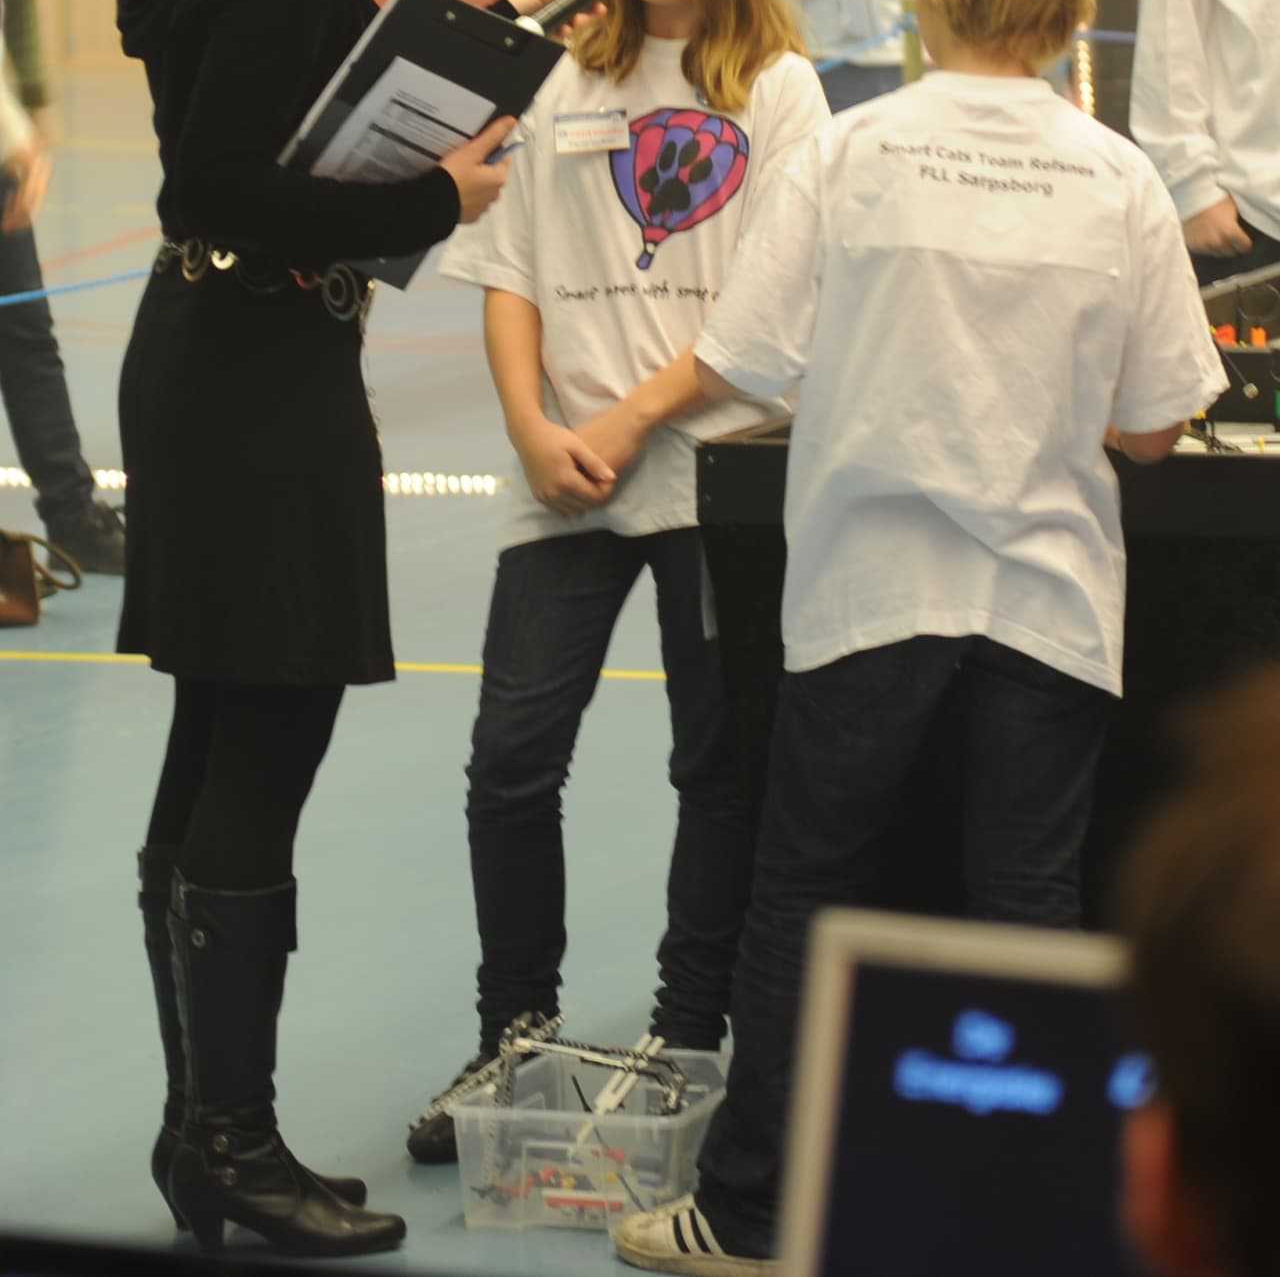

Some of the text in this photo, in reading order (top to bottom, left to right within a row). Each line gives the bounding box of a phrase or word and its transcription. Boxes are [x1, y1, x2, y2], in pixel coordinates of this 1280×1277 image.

[879, 140, 931, 158] Smart
[936, 145, 972, 163] Cats
[978, 151, 1024, 169] Team
[920, 164, 1054, 198] FLL Sarpsborg
